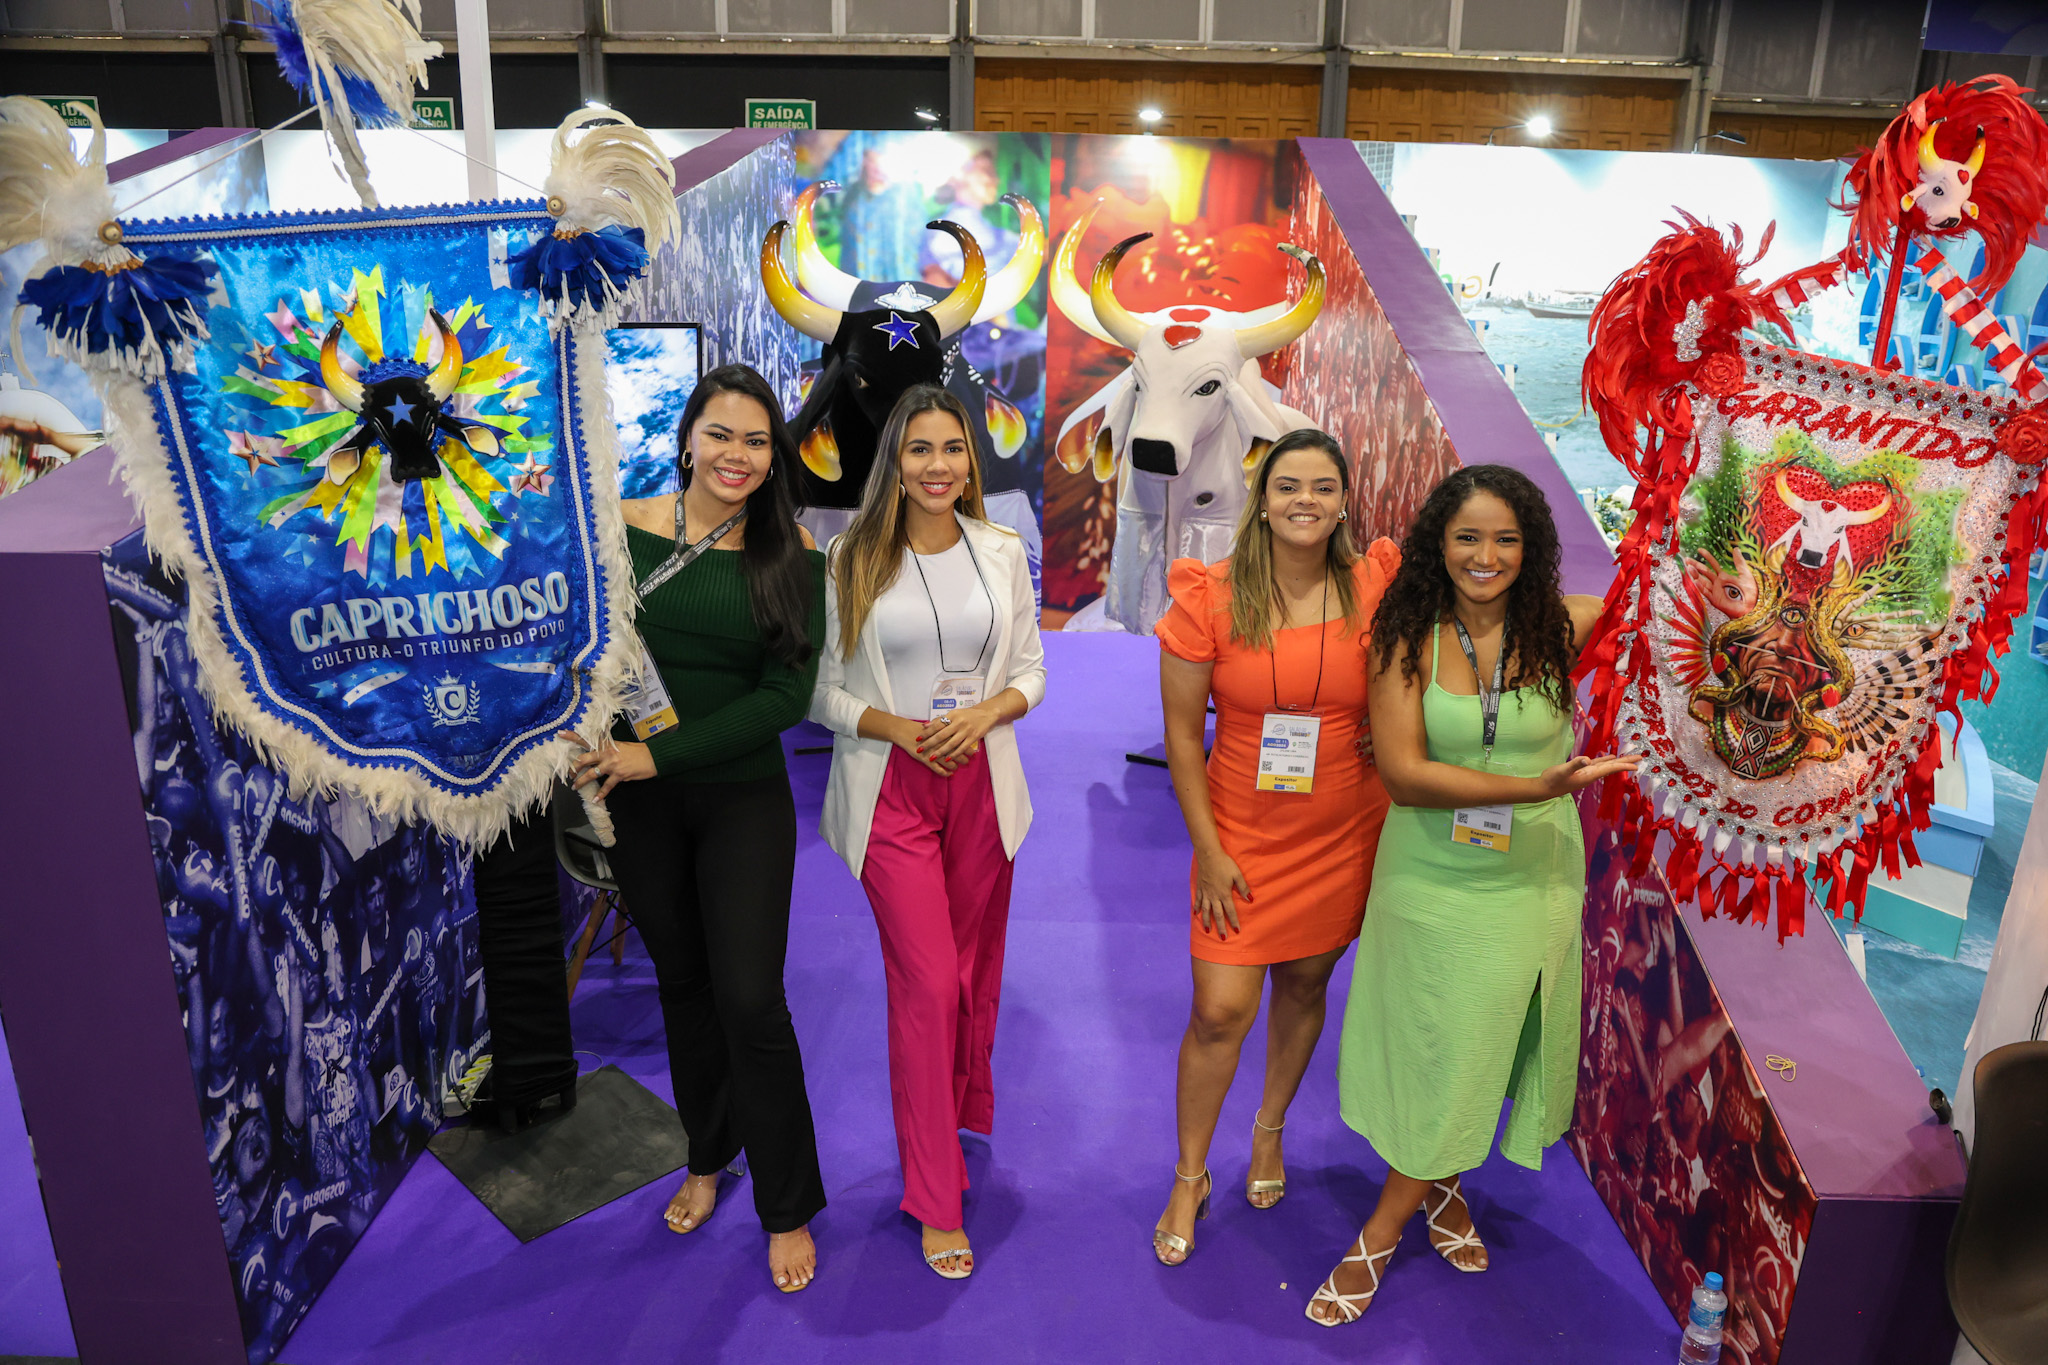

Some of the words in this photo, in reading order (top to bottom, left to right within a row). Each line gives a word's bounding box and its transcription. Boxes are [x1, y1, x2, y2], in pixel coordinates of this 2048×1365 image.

[416, 104, 444, 118] ÍDA
[754, 105, 805, 120] SAÍDA
[763, 120, 809, 129] EMERGÊNCIA
[1715, 383, 1998, 469] GARANTIDO
[289, 570, 570, 653] CAPRICHOSO
[422, 636, 496, 657] TRIUNFO
[500, 631, 525, 648] DO
[528, 618, 567, 643] POVO
[1719, 796, 1758, 819] DO
[1470, 829, 1495, 839] Expositor
